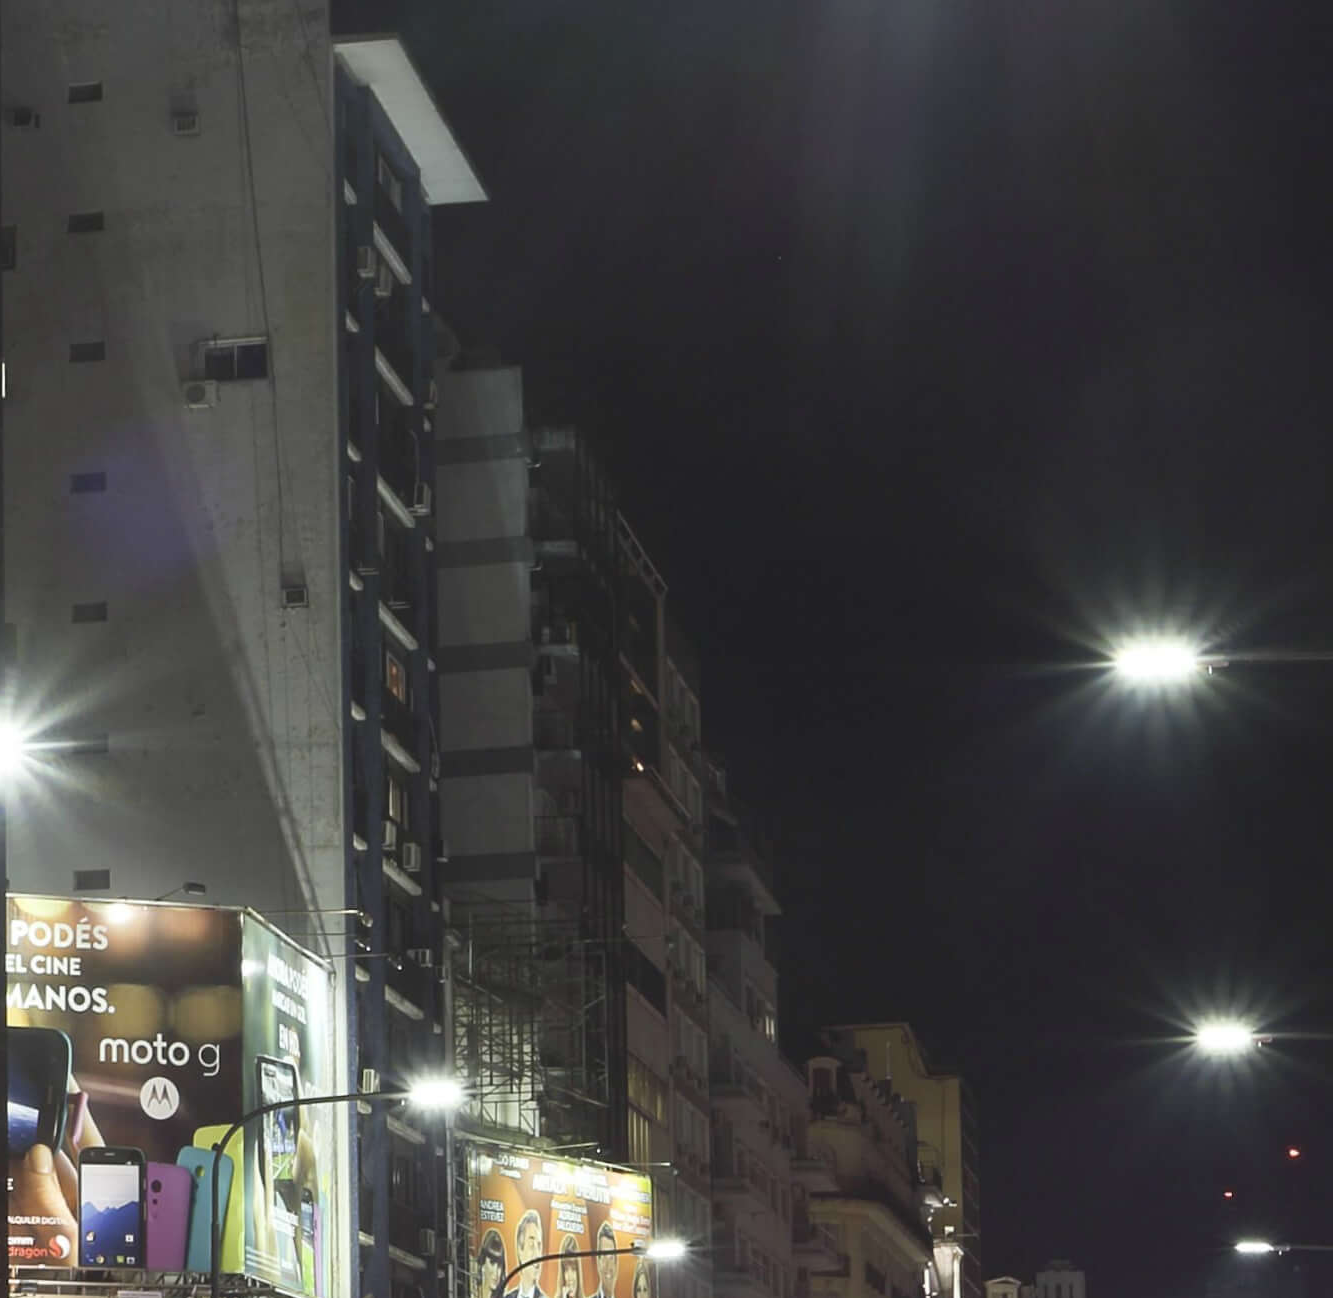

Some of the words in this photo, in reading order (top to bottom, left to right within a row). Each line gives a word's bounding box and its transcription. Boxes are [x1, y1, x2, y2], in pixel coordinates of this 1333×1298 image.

[10, 916, 109, 951] PODÉS
[30, 955, 82, 976] CINE
[99, 1034, 191, 1066] moto
[198, 1043, 221, 1077] g
